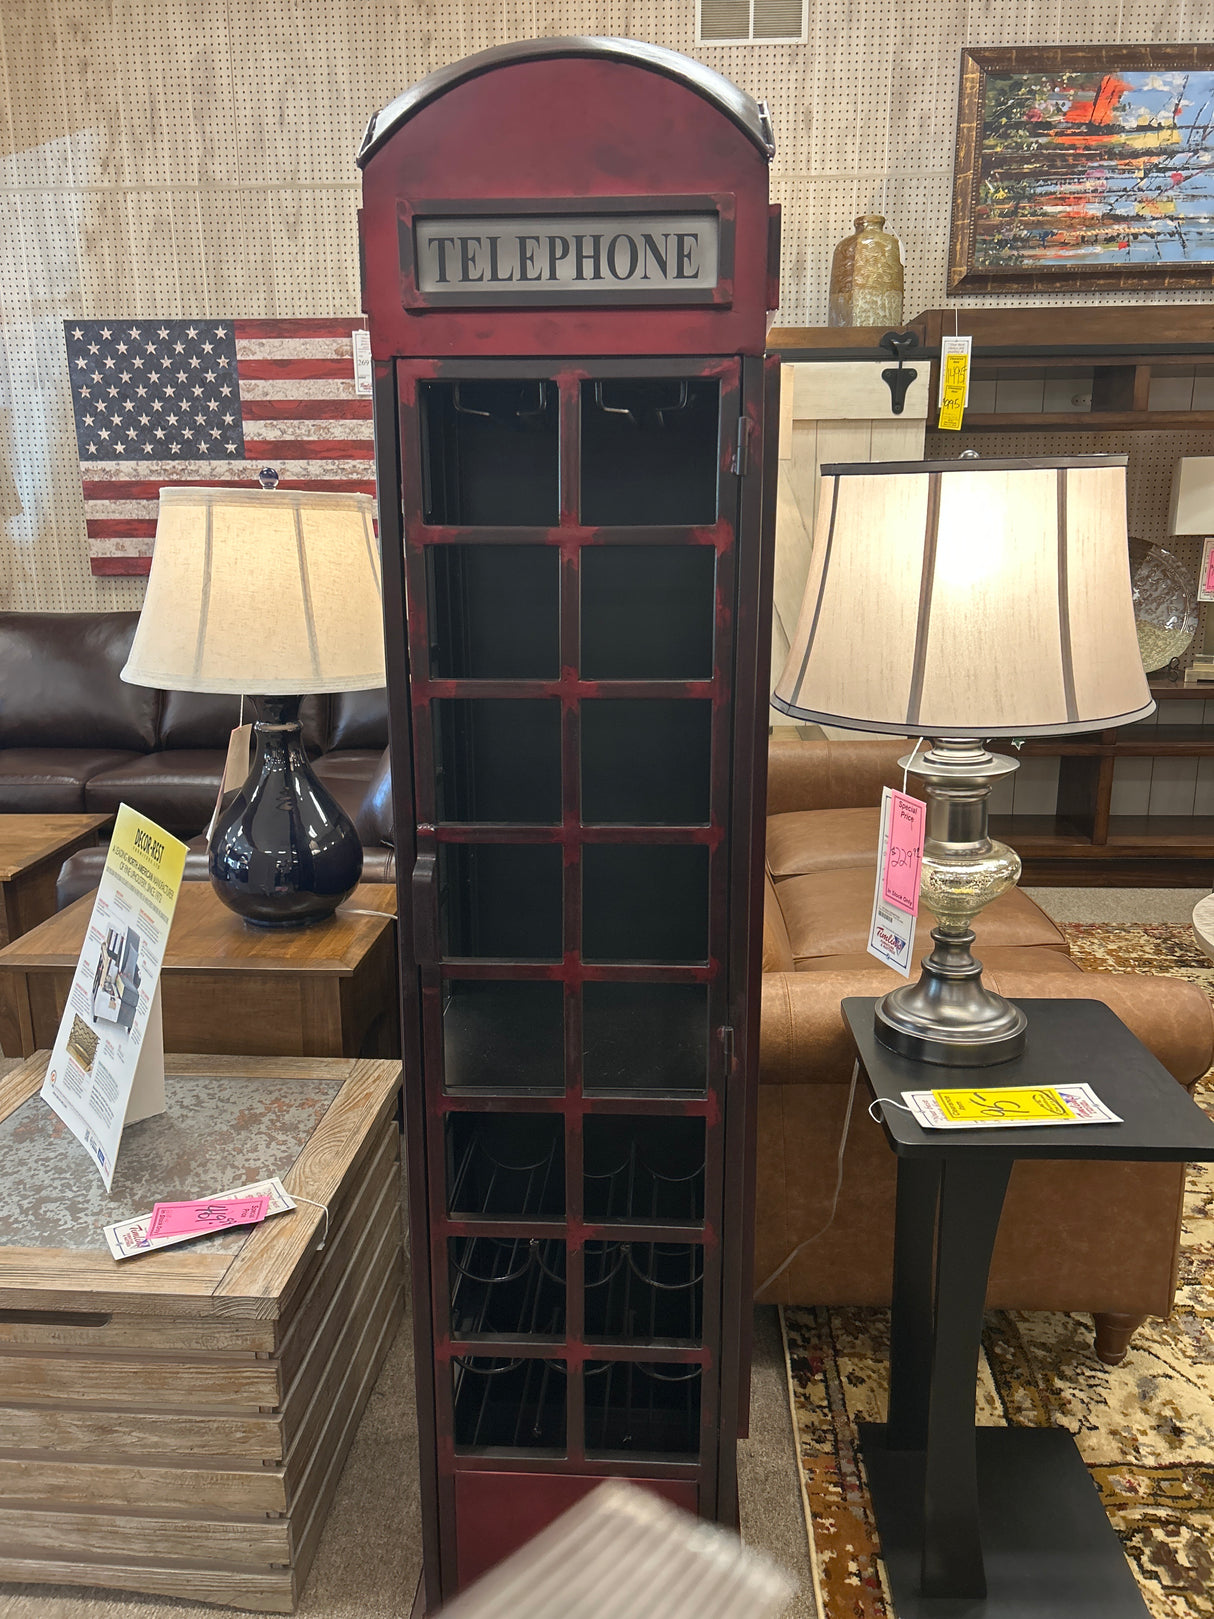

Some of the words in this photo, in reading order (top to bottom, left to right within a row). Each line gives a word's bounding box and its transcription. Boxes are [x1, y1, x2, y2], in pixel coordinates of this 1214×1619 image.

[428, 233, 700, 283] TELEPHONE
[899, 801, 918, 814] Special
[900, 811, 914, 822] Price
[134, 828, 164, 864] DECOR-REST
